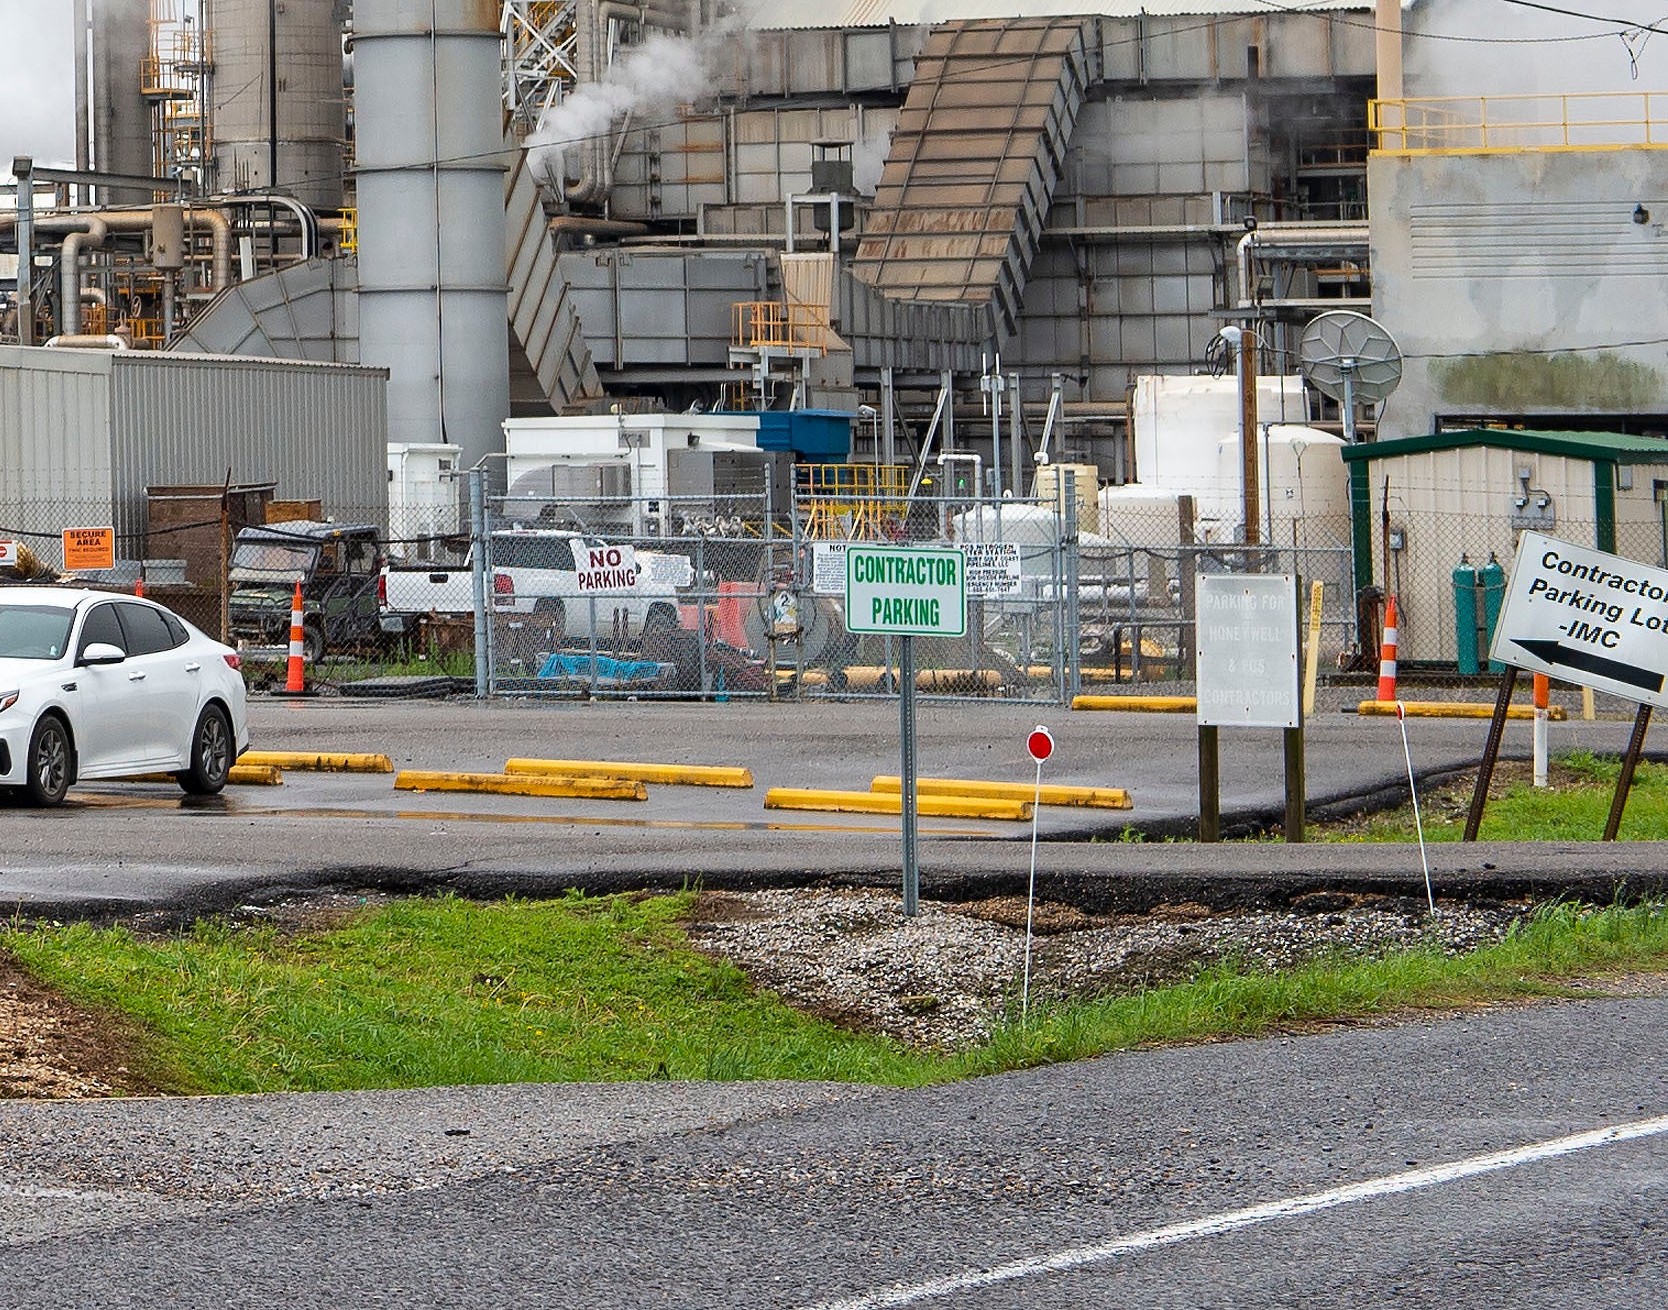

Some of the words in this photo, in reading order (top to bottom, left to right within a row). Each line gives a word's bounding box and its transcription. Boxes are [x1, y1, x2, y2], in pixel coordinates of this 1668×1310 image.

[589, 549, 622, 568] NO
[829, 544, 846, 552] NOT
[578, 569, 636, 590] PARKING
[854, 554, 956, 586] CONTRACTOR
[1206, 593, 1258, 610] PARKING
[1263, 595, 1286, 610] FOR
[1528, 578, 1624, 623] Parking
[872, 597, 940, 627] PARKING
